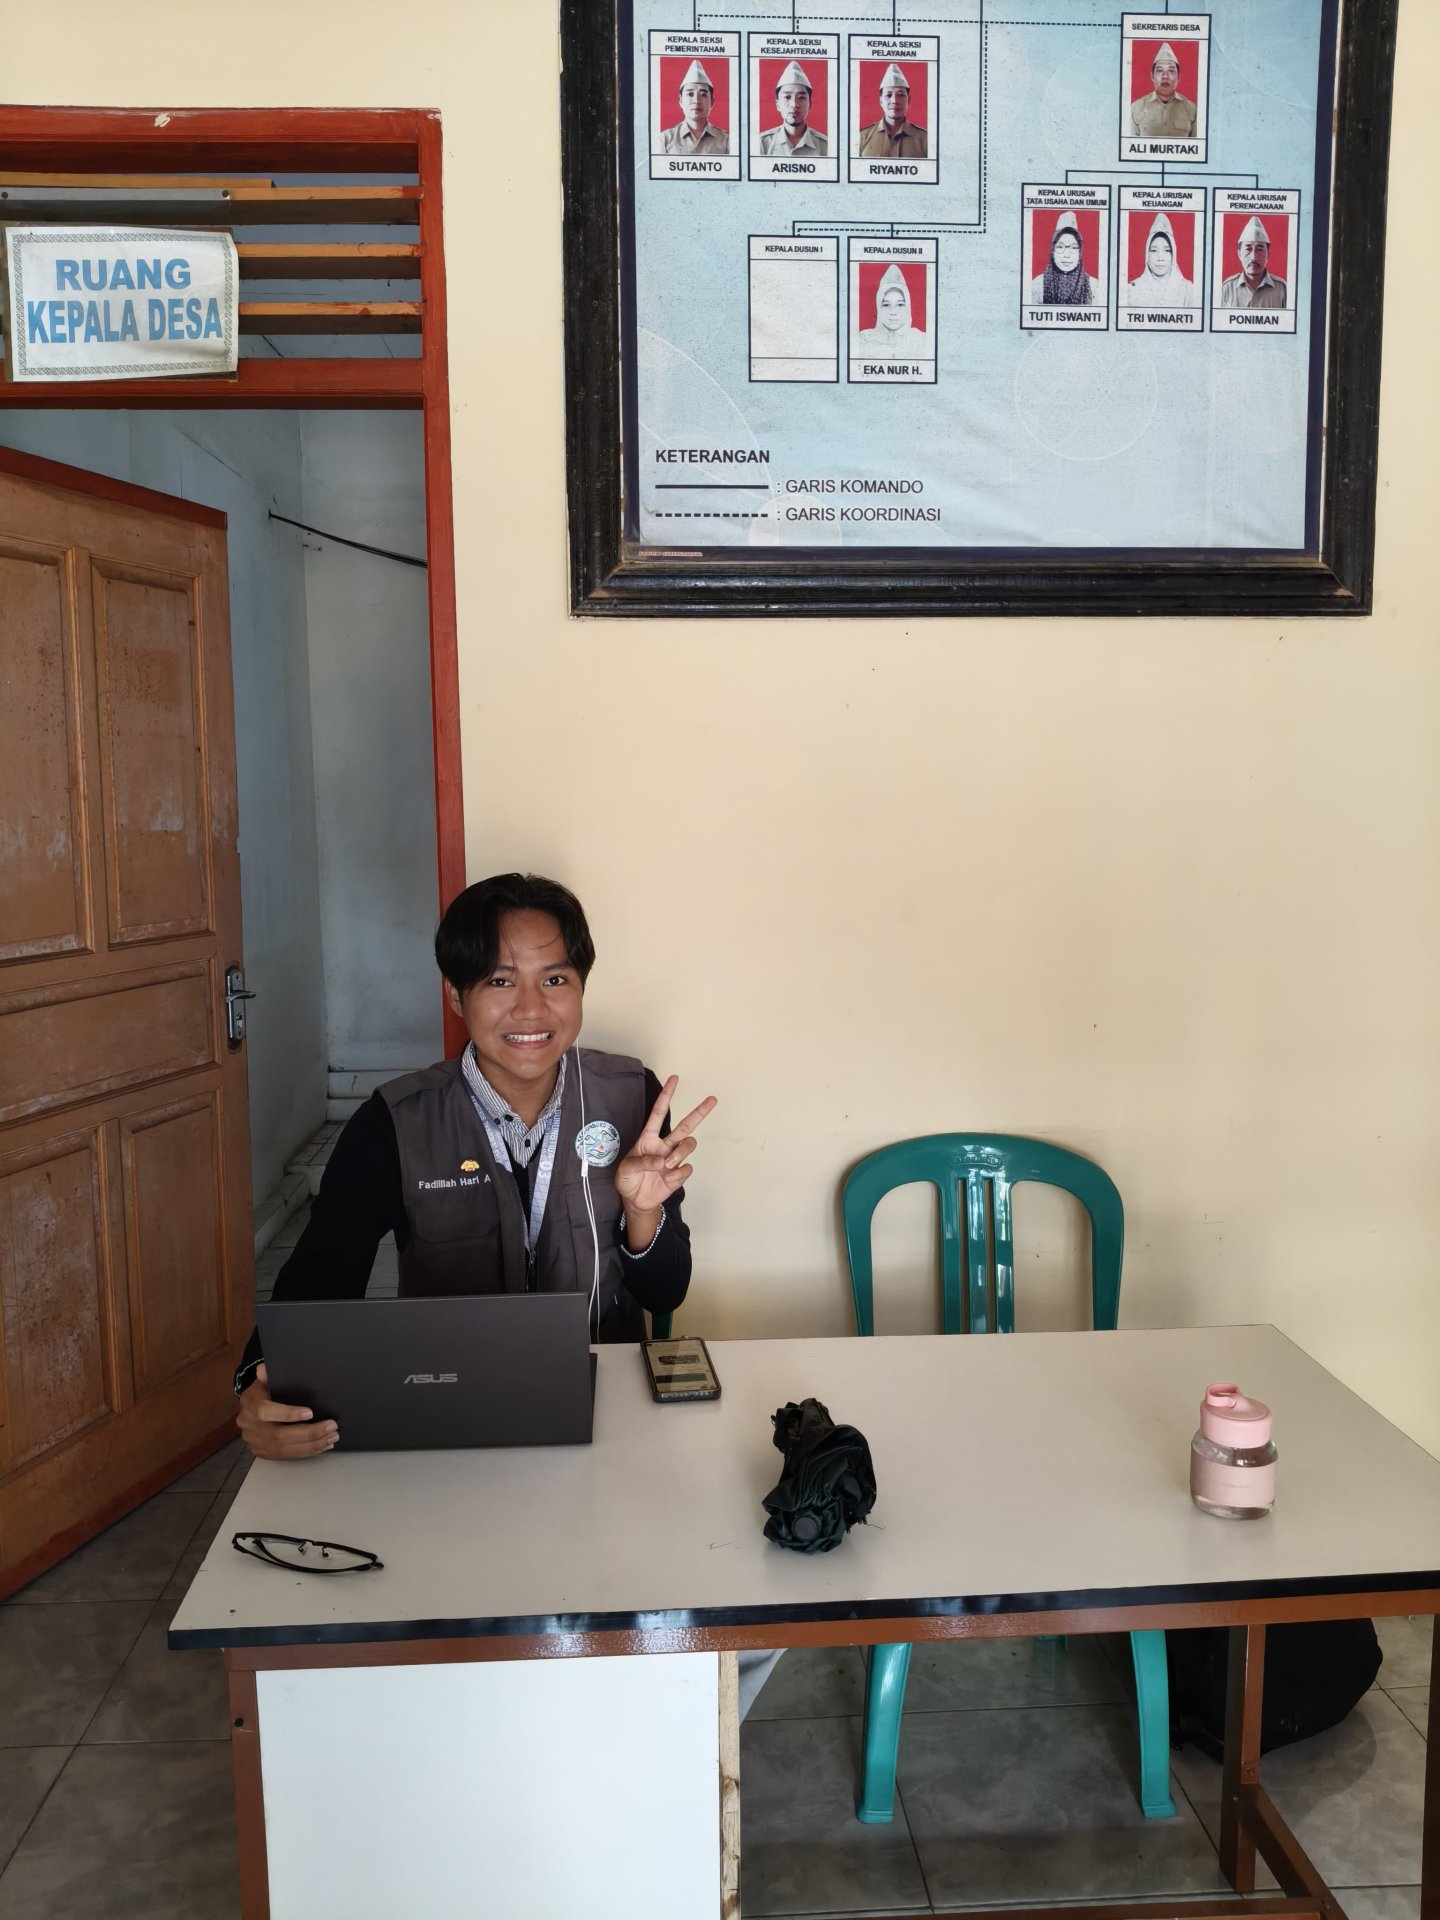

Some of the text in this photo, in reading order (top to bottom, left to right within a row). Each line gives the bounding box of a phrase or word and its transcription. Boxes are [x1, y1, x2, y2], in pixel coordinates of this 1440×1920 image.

[1131, 22, 1201, 32] SEKRETARIS DESA
[667, 35, 723, 44] KEPALA SEKSI
[766, 38, 822, 46] KEPALA SEKSI
[867, 40, 922, 49] KEPALA SEKSI
[664, 44, 726, 53] PEMERINTAHAN
[760, 46, 828, 56] KESEJAHTERAAN
[871, 49, 917, 58] PELAYANAN
[1128, 143, 1199, 155] ALI MURTAKI
[669, 161, 723, 172] SUTANTO
[771, 163, 816, 174] ARISNO
[869, 164, 919, 176] RIYANTO
[1037, 189, 1096, 197] KEPALA URUSAN
[1132, 191, 1193, 200] KEPALA URUSAN
[1227, 193, 1287, 202] KEPALA URUSAN
[1026, 197, 1044, 205] TATA
[1043, 198, 1069, 206] USAHA
[1069, 198, 1085, 206] DAN
[1141, 200, 1183, 208] KEUANGAN
[1229, 202, 1285, 211] PERENCANAAN
[765, 245, 794, 253] KEPALA
[794, 245, 819, 253] DUSUN
[863, 246, 892, 254] KEPALA
[892, 247, 918, 255] DUSUN
[55, 258, 191, 292] RUANG
[27, 297, 224, 344] KEPALA DESA
[1028, 311, 1101, 322] TUTI ISWANTI
[1126, 313, 1194, 324] TRI WINARTI
[1229, 314, 1279, 326] PONIMAN
[863, 364, 923, 376] EKA NUR H.
[655, 449, 770, 464] KETERANGAN
[785, 479, 836, 494] GARIS
[840, 479, 924, 494] KOMANDO
[785, 507, 836, 522] GARIS
[840, 507, 941, 522] KOORDINASI
[484, 1174, 492, 1183] A
[403, 1373, 458, 1384] ASUS
